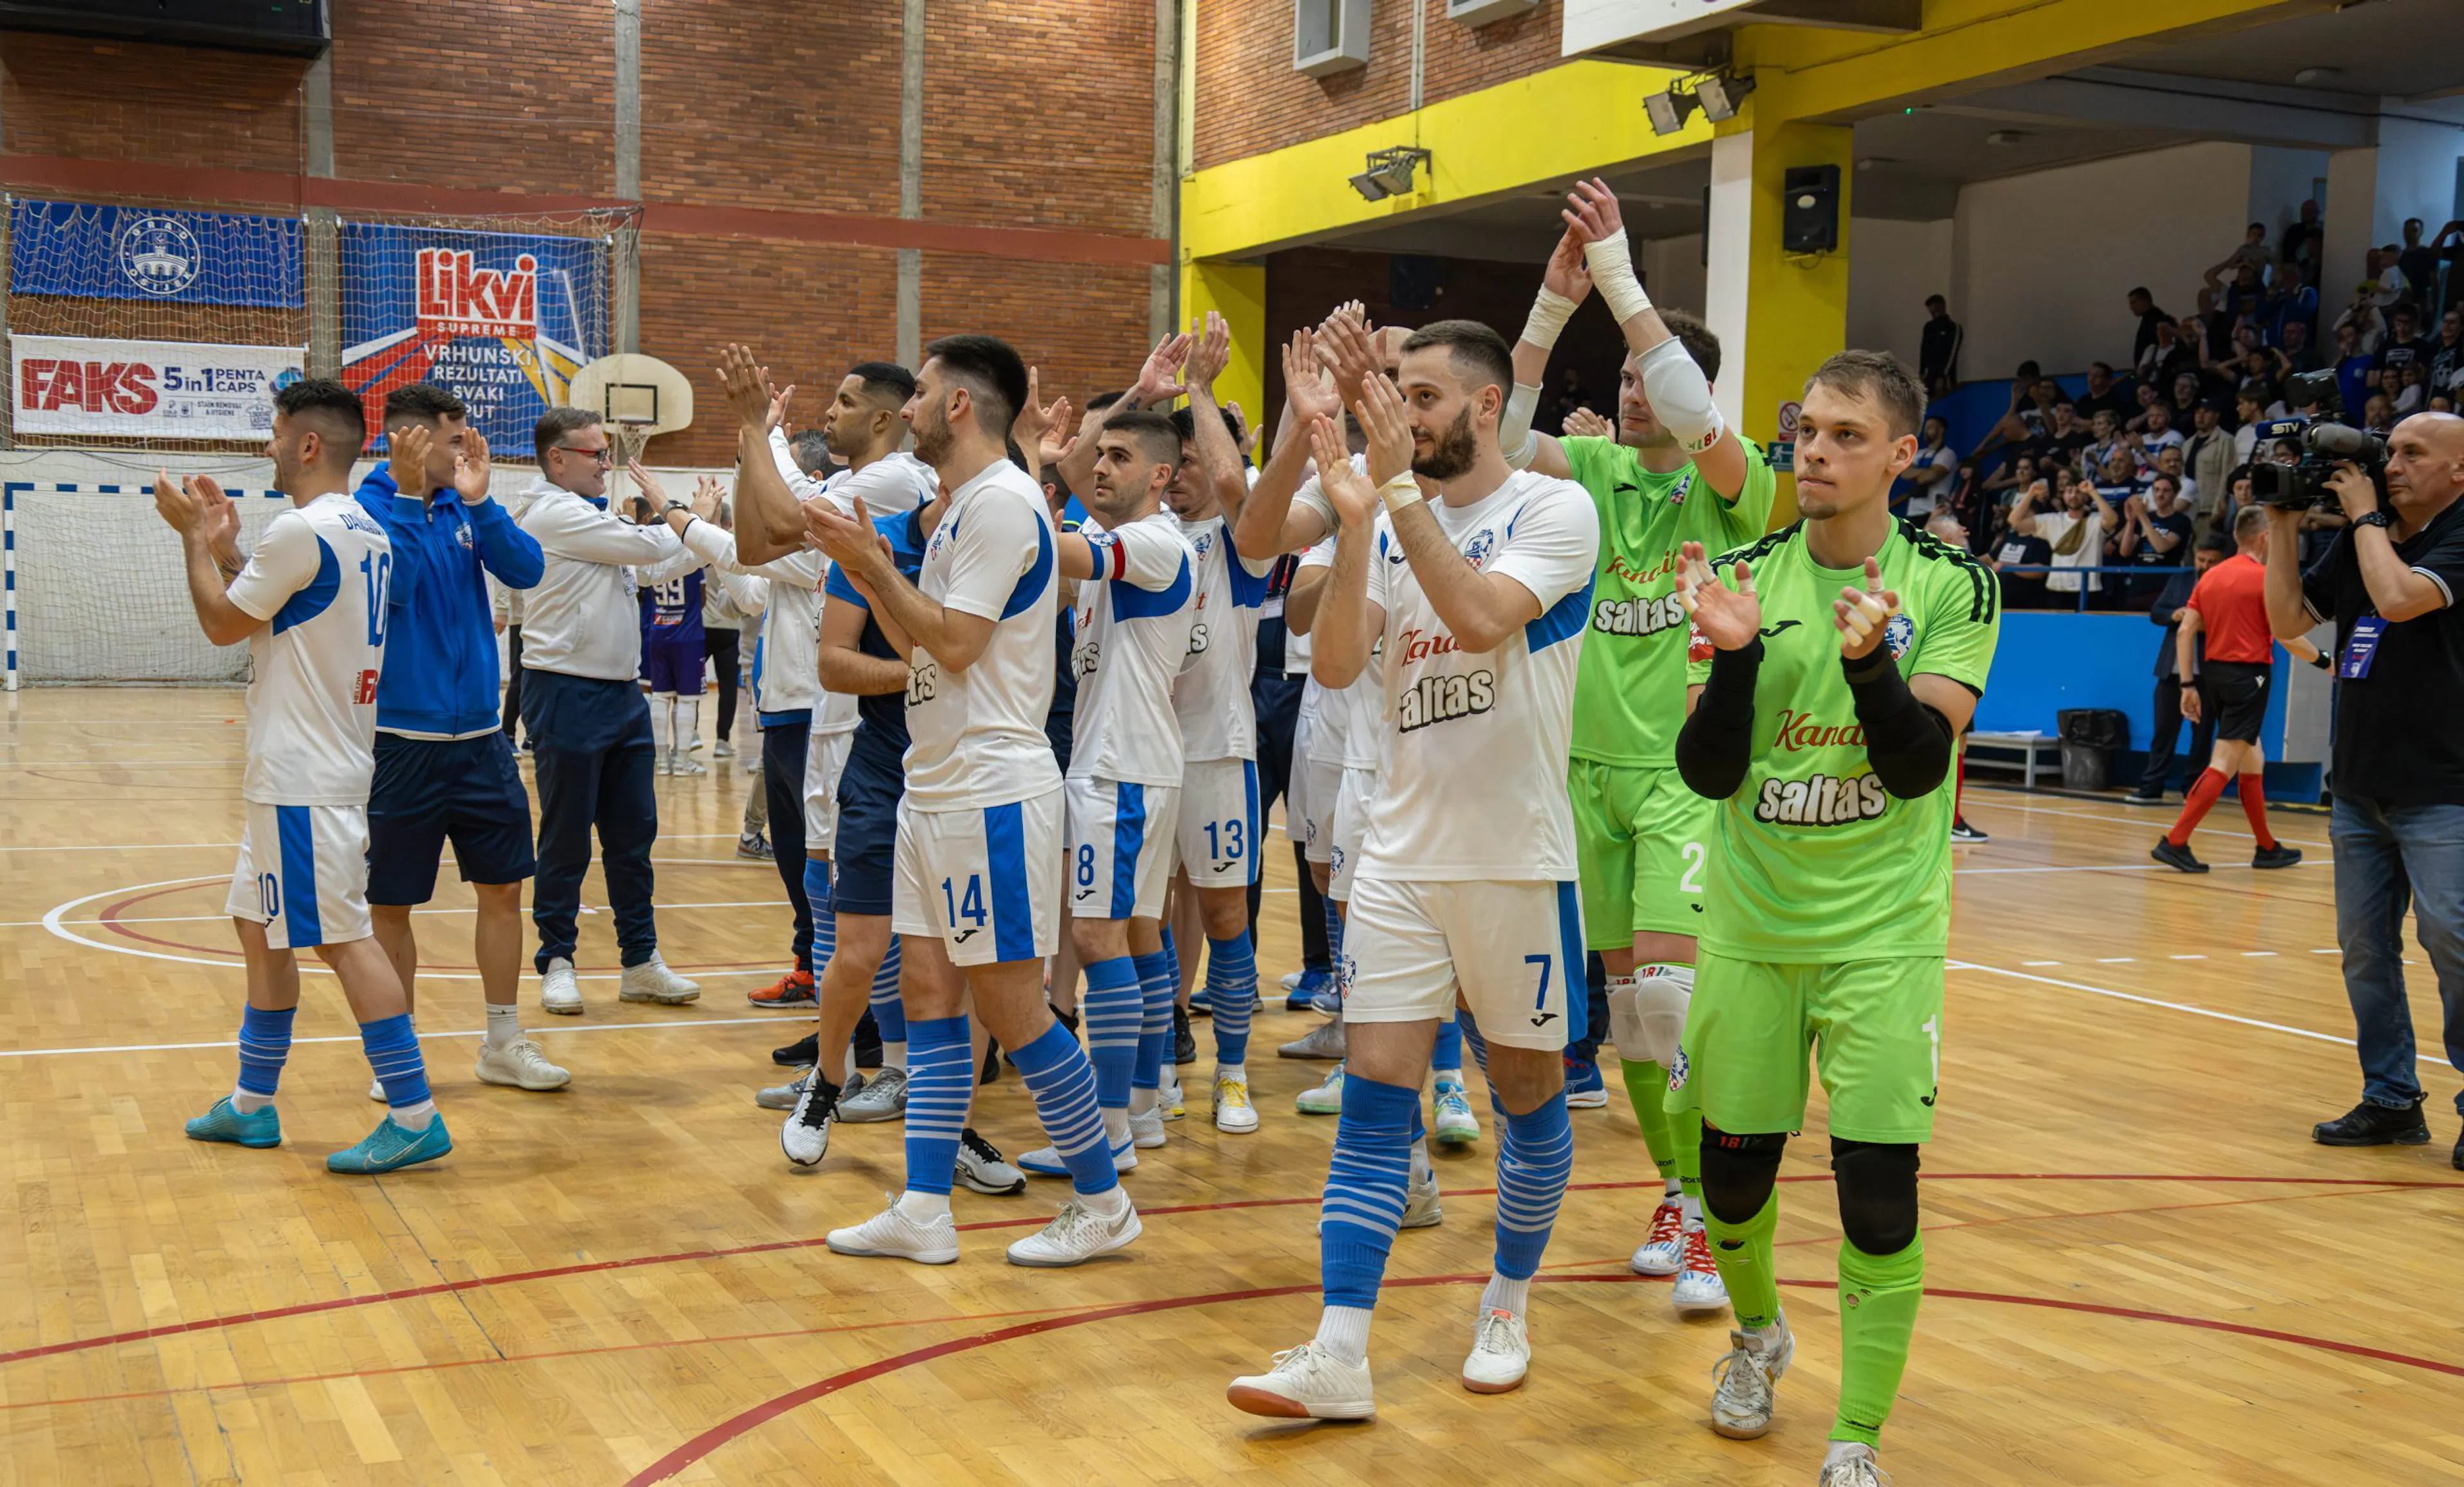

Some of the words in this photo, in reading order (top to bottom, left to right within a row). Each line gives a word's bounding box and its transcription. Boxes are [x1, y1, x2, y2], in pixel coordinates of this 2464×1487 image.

[132, 221, 188, 240] GRAD
[130, 268, 193, 291] OSIJEK
[437, 321, 517, 337] SUPREME
[216, 368, 266, 381] PENTA
[424, 344, 532, 366] VRHUNSKI
[434, 365, 522, 384] REZULTATI
[21, 358, 158, 415] FAKS
[216, 381, 257, 393] CAPS
[452, 385, 504, 402] SVAKI
[2271, 422, 2300, 434] STV
[360, 549, 390, 648] 10
[1592, 590, 1686, 637] saltas
[1399, 669, 1495, 734] altas
[1754, 772, 1887, 827] saltas
[1203, 818, 1244, 860] 13
[1077, 844, 1095, 886] 8
[257, 871, 279, 917] 10
[942, 874, 987, 928] 14
[1525, 953, 1553, 1010] 7
[1922, 1014, 1939, 1083] 1
